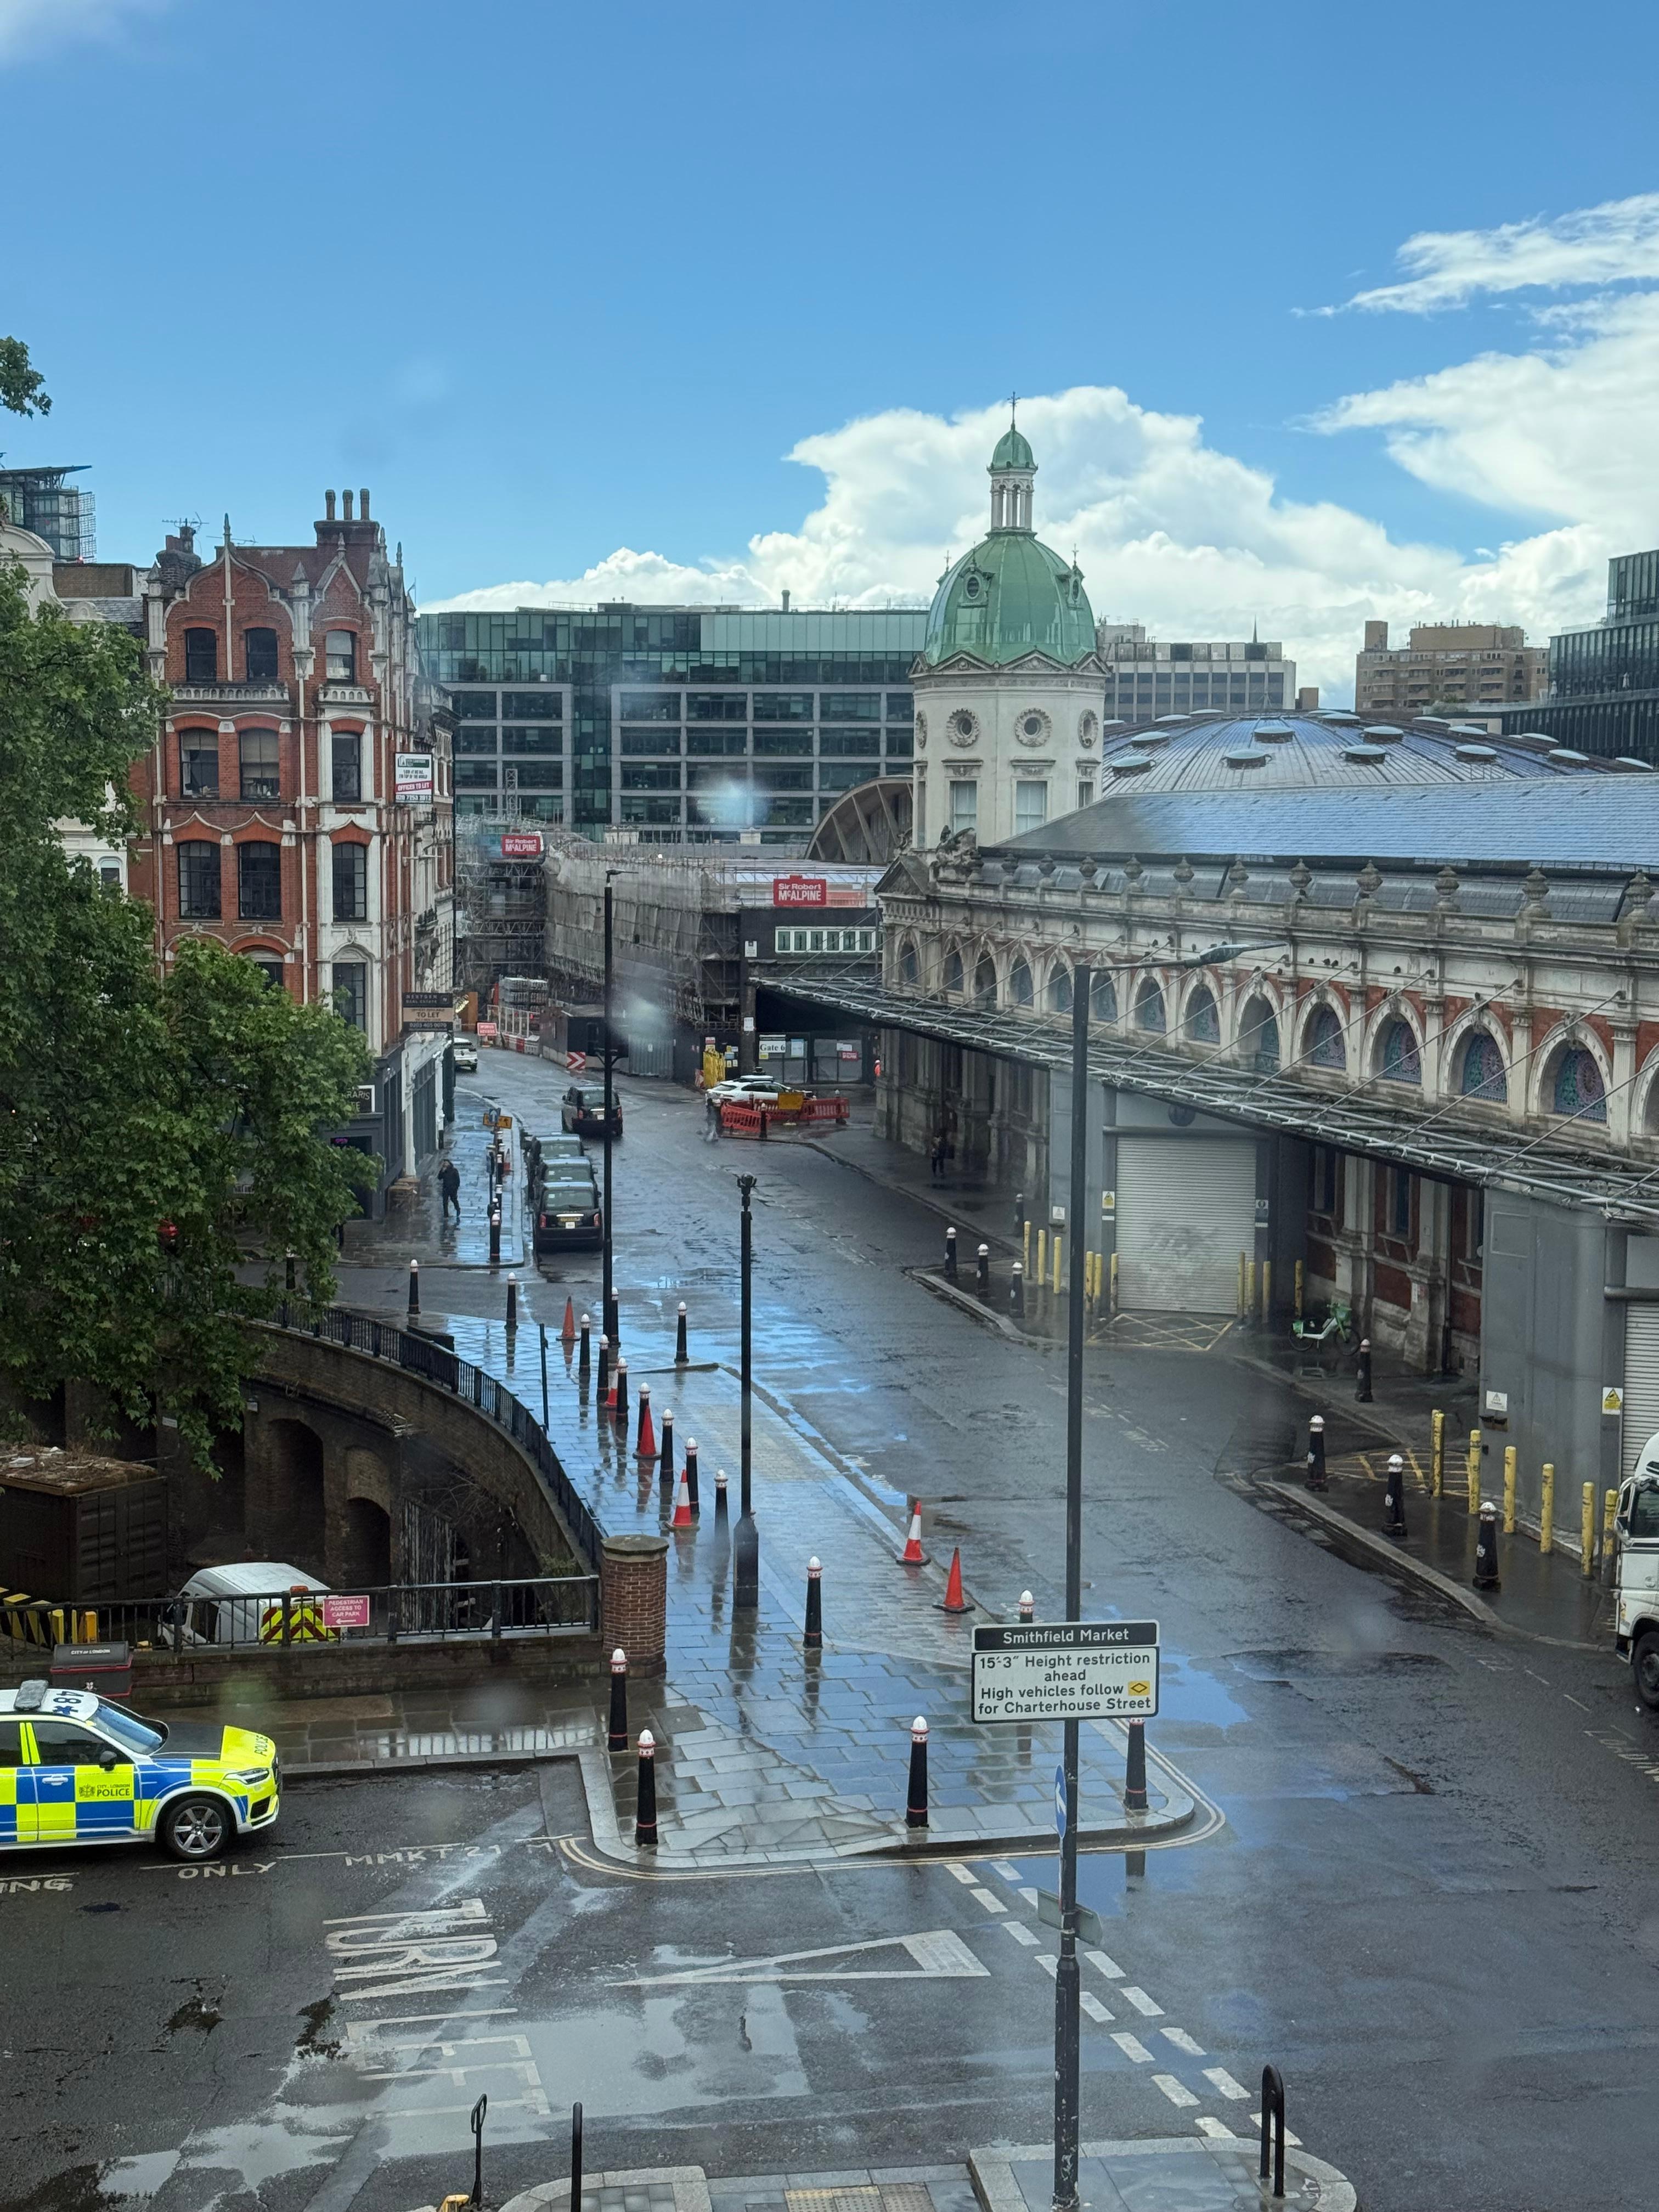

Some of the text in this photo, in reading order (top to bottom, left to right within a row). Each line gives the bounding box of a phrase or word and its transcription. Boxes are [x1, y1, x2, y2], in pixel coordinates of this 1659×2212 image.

[778, 890, 821, 901] McALPINE
[1003, 1628, 1129, 1644] Smithfield Market
[1025, 1654, 1072, 1669] Height
[1077, 1652, 1150, 1666] restriction
[1044, 1669, 1086, 1682] ahead
[981, 1683, 1124, 1701] High vehicles follow
[978, 1697, 1151, 1715] for Charterhouse Street
[97, 1788, 130, 1797] POLICE
[178, 1862, 277, 1879] ONLY
